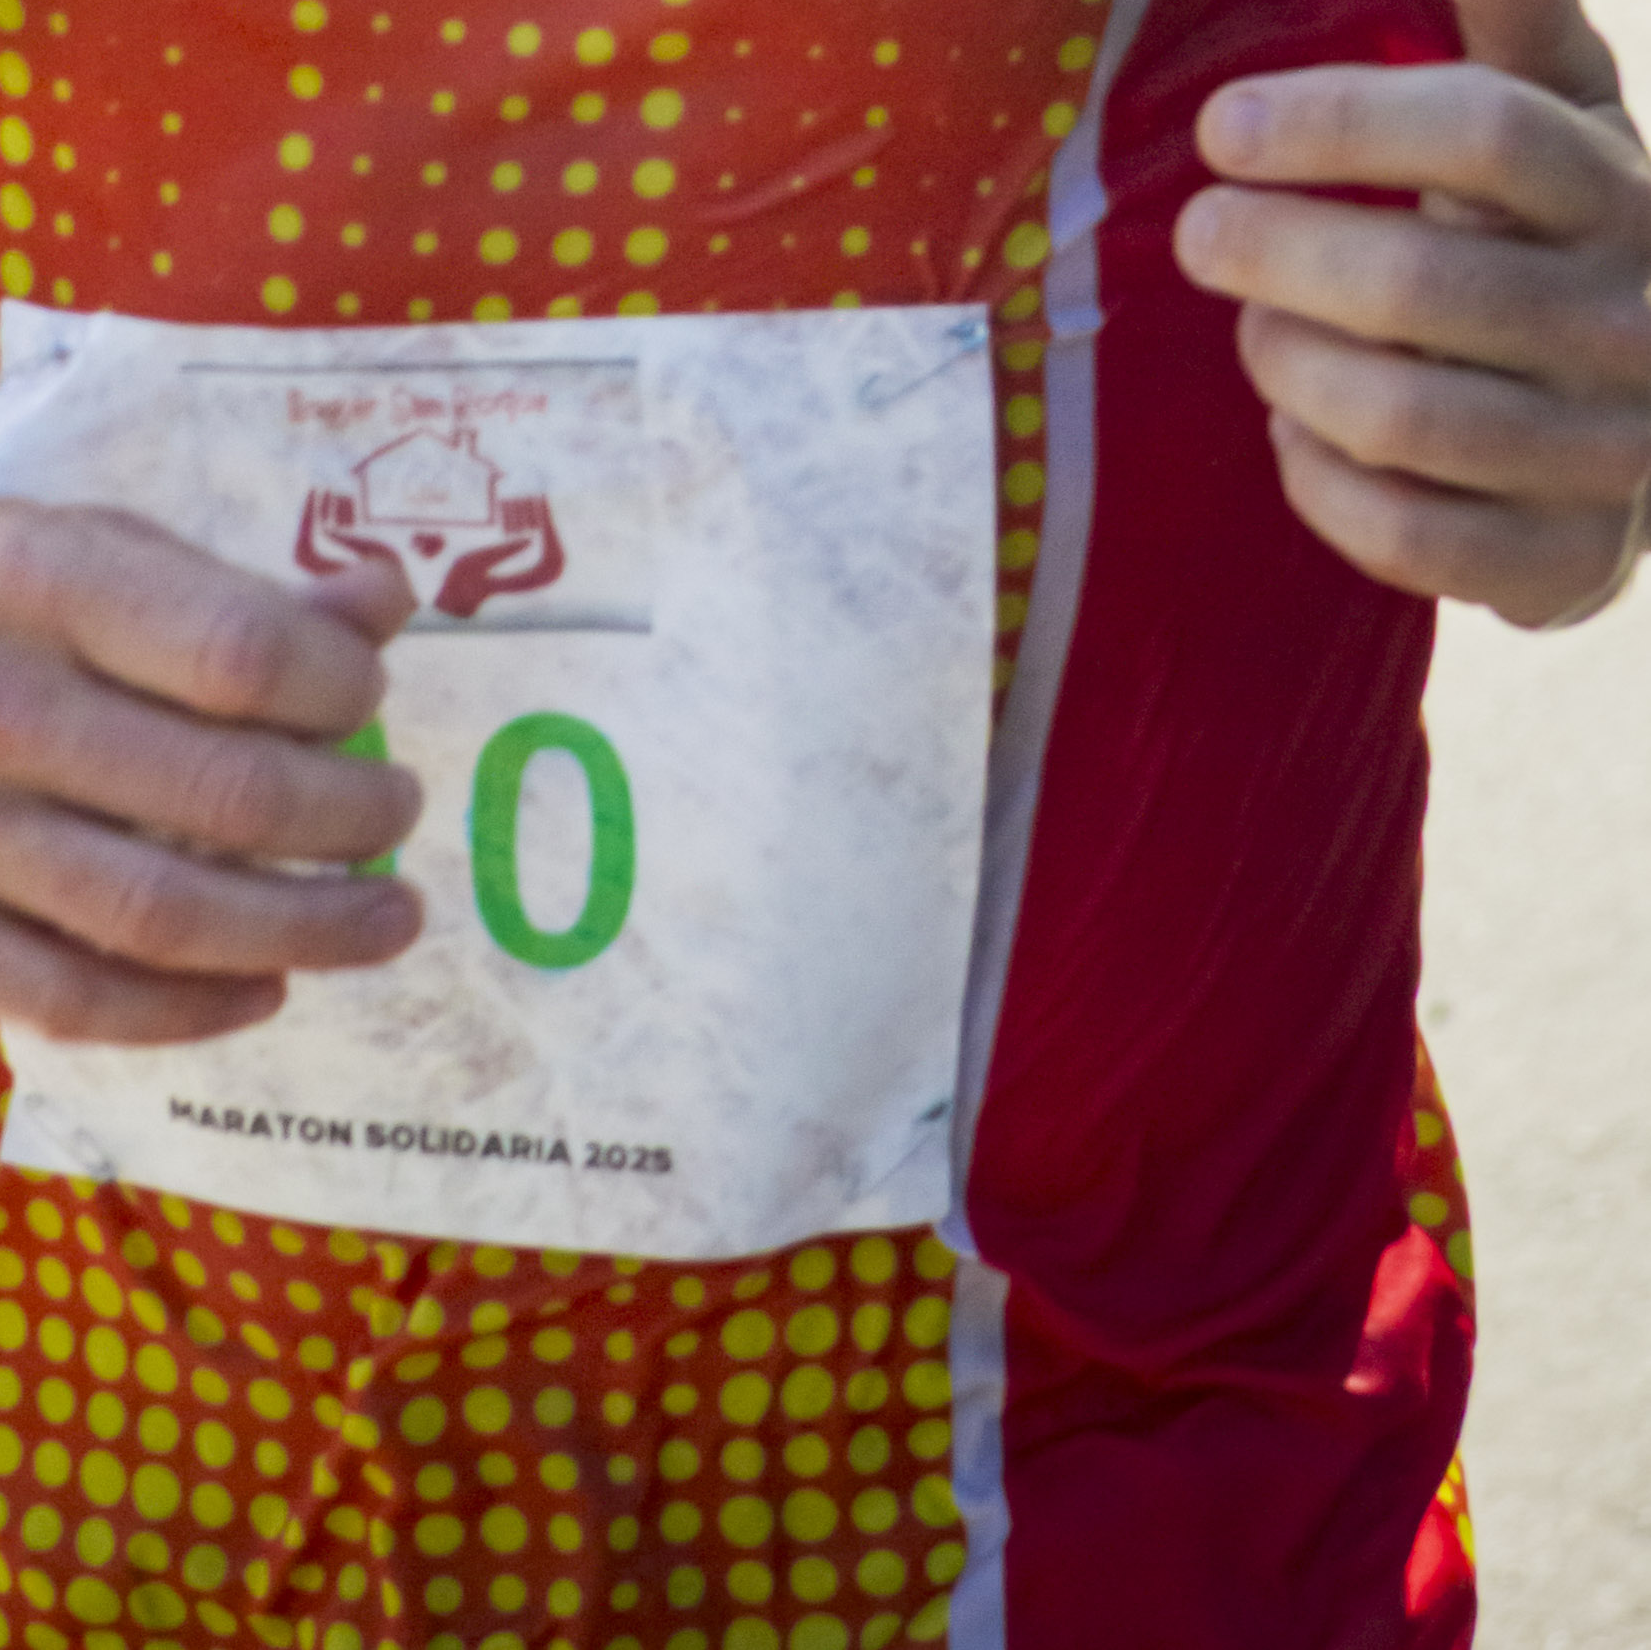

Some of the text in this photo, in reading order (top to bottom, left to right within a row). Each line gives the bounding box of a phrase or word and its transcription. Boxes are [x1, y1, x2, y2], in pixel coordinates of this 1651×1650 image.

[167, 1097, 673, 1175] MARATON SOLIDARIA 2025
